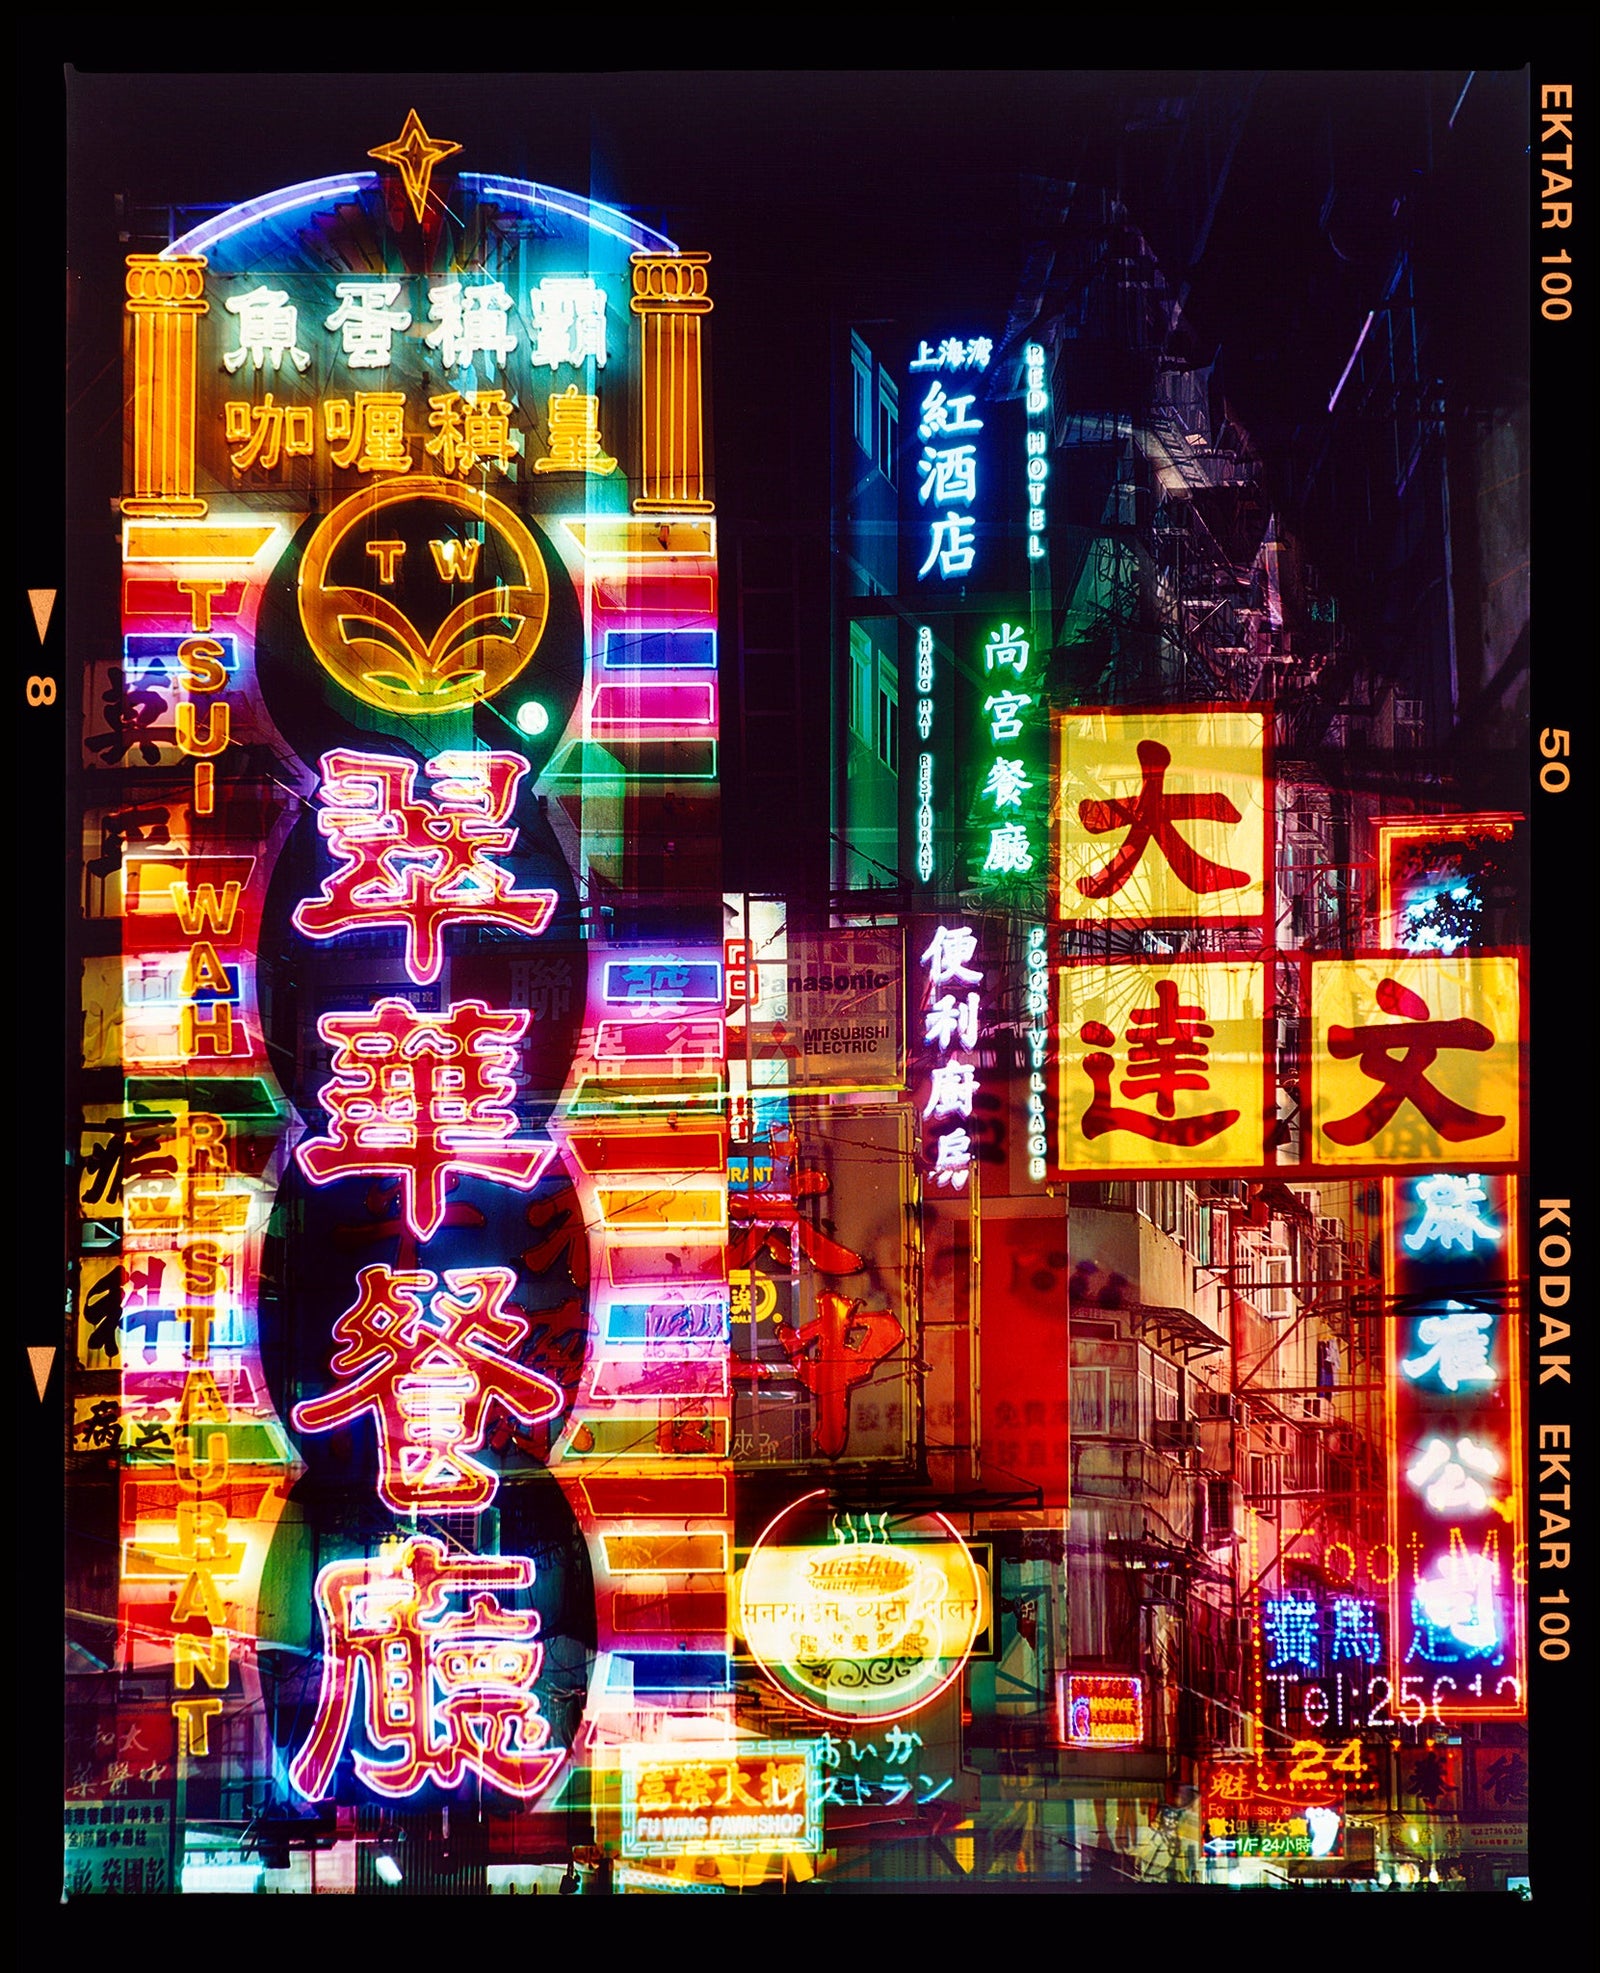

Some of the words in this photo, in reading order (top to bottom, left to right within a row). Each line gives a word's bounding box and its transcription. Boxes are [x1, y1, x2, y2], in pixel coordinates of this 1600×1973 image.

[1540, 83, 1574, 230] EKTAR
[223, 277, 609, 374] 魚蛋稱霸
[1540, 249, 1574, 322] 100
[1026, 344, 1047, 414] RED
[224, 384, 619, 476] 咖喱稱皇
[917, 380, 984, 582] 紅酒店
[1027, 431, 1047, 559] HOTEL
[366, 540, 406, 585] T
[429, 538, 480, 584] W
[25, 675, 58, 708] 8
[175, 578, 231, 815] TSUI
[983, 622, 1034, 874] 尚宮餐廳
[1540, 726, 1572, 795] 50
[919, 753, 934, 883] RESTAURANT
[170, 881, 242, 1058] WAH
[1027, 928, 1048, 1015] FOOD
[804, 1026, 890, 1042] MITSUBISHI
[804, 1040, 878, 1056] ELECTRIC
[1320, 978, 1507, 1147] 文
[1027, 1031, 1048, 1181] VILLAGE
[289, 746, 565, 1801] 翠華餐廳
[1537, 1198, 1571, 1386] KODAK
[171, 1112, 231, 1757] RESTAURANT
[1537, 1423, 1571, 1571] EKTAR
[1280, 1528, 1425, 1585] Foot
[1537, 1589, 1571, 1663] 100
[1089, 1696, 1135, 1710] MASSAGE
[1289, 1739, 1368, 1781] 24
[638, 1817, 661, 1839] FU
[662, 1816, 708, 1839] WING
[709, 1813, 805, 1838] PAWNSHOP
[1236, 1837, 1259, 1853] 1/F
